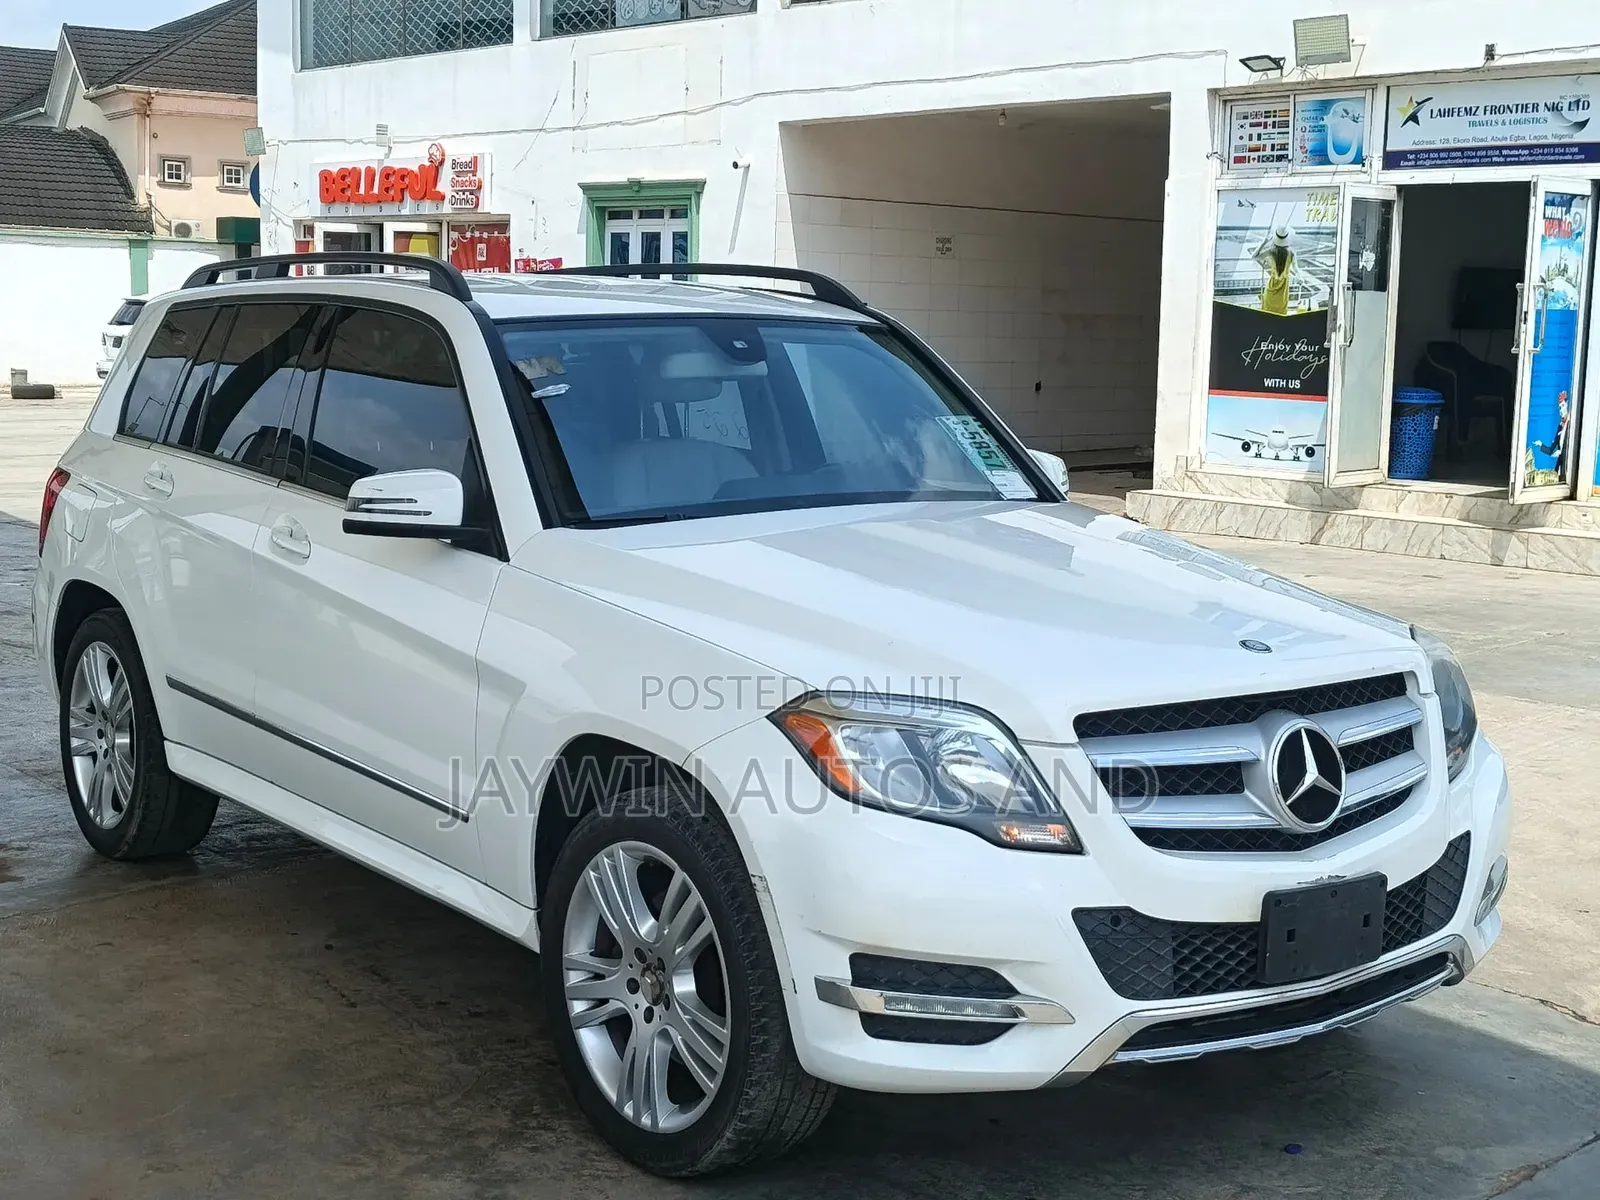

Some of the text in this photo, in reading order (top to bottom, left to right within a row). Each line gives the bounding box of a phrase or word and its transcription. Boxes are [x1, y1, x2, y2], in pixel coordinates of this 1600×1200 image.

[1430, 99, 1590, 119] LAHFEMZ FRONTIER NIG LTD
[1468, 117, 1548, 128] TRAVELS & LOGISTICS
[451, 159, 472, 170] Bread
[318, 163, 446, 204] BELLEFUL
[450, 176, 477, 188] Snacks
[450, 194, 475, 206] Drinks
[1306, 192, 1339, 206] TIME
[1261, 342, 1319, 353] Enjoy Your
[1241, 335, 1328, 380] Holidays
[1264, 378, 1301, 389] WITH US
